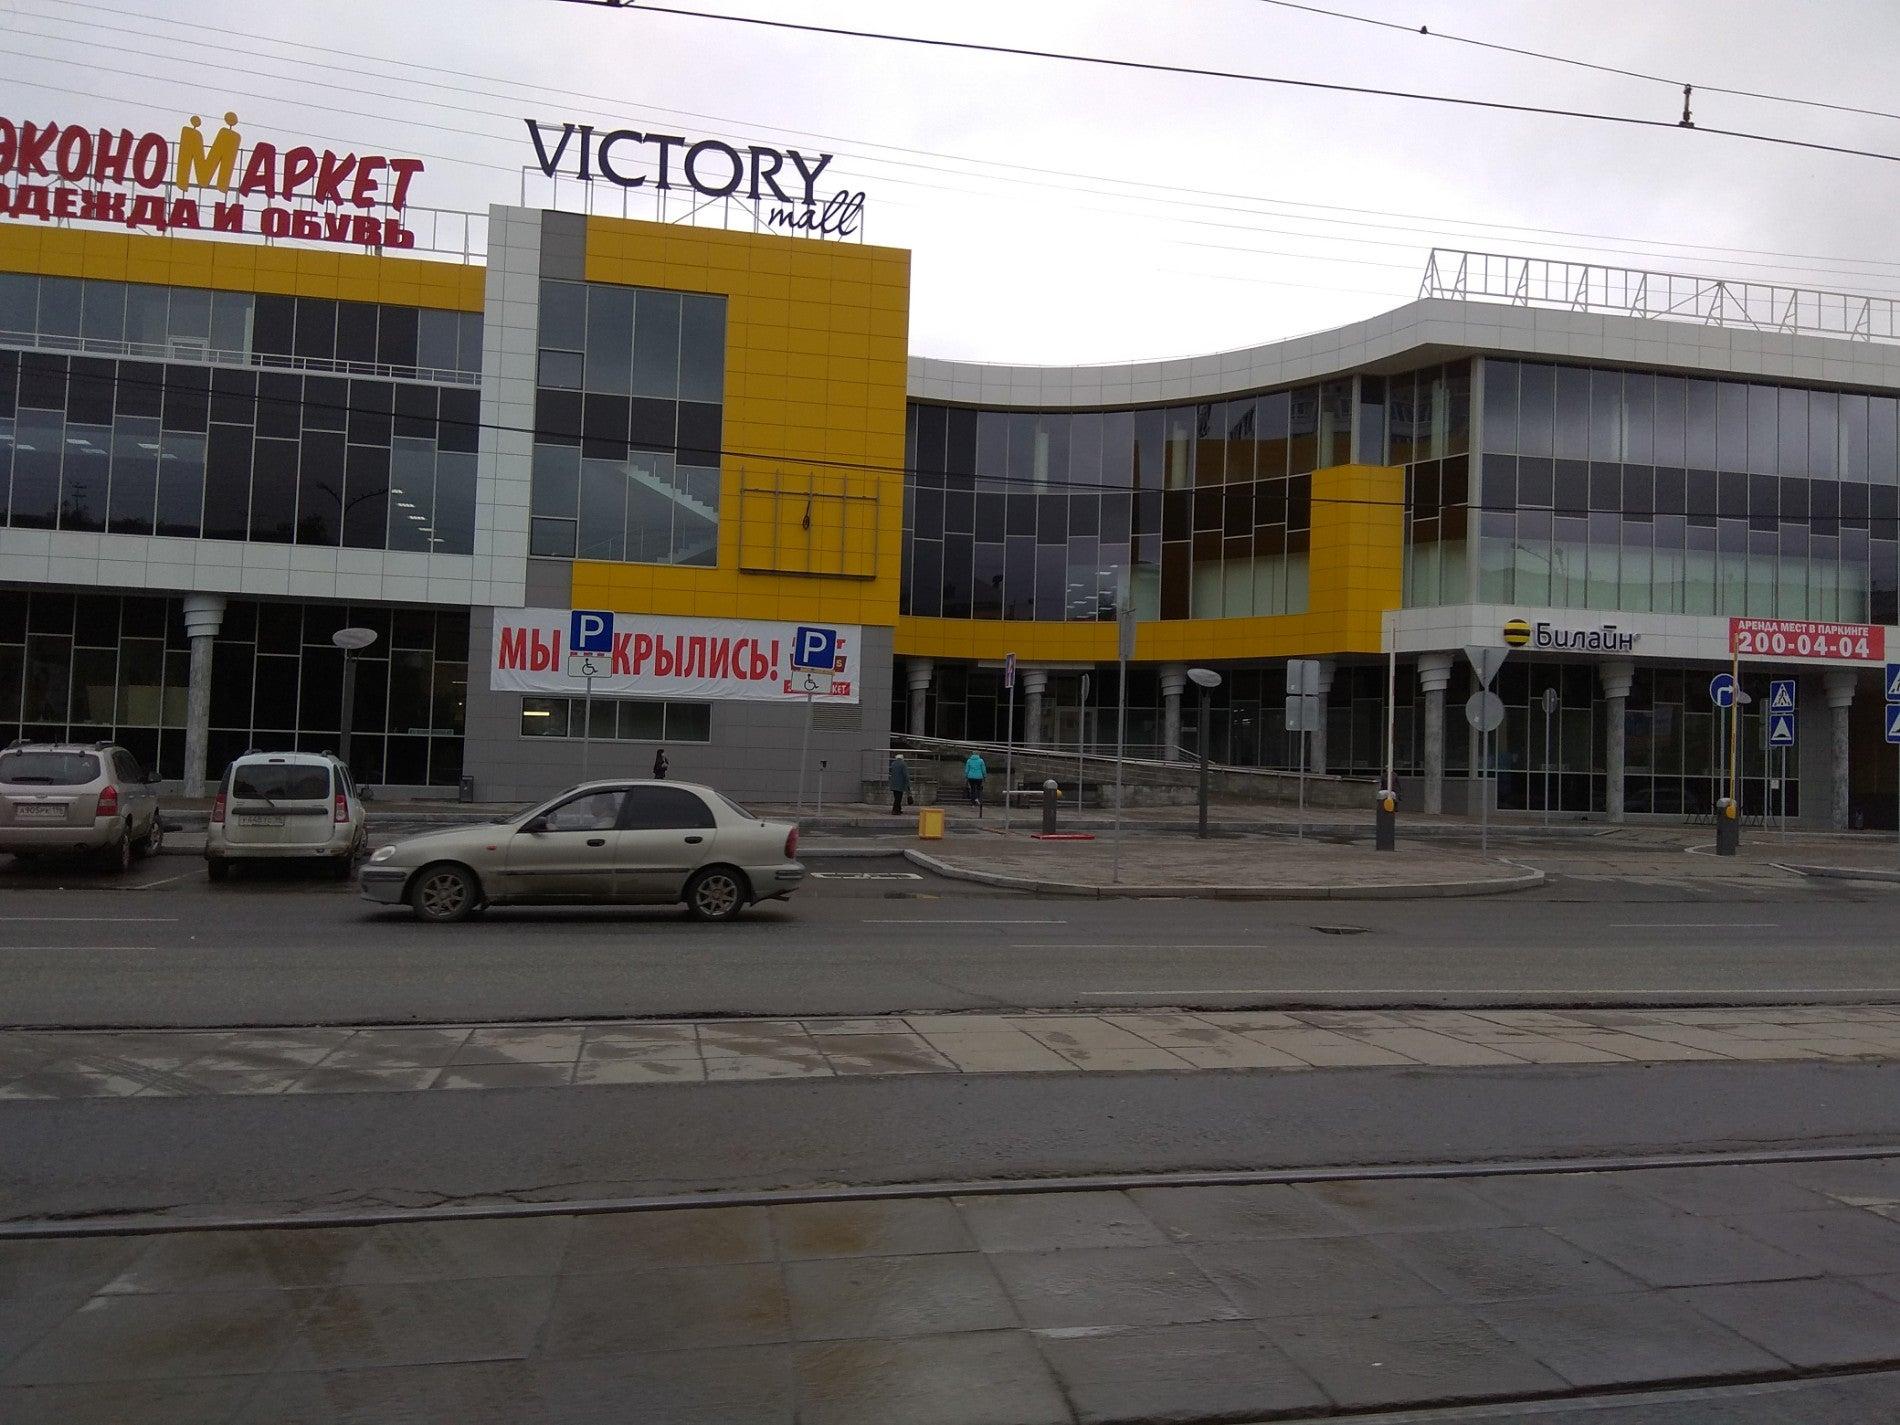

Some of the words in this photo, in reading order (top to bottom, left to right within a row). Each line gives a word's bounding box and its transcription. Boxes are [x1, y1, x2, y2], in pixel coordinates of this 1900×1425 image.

[524, 119, 833, 206] VICTORY
[213, 202, 244, 233] И
[260, 207, 414, 249] ОБУВЬ
[768, 190, 866, 236] mall
[579, 614, 604, 648] P
[1536, 622, 1633, 651] Билайн
[1737, 631, 1870, 658] 200-04-04
[1738, 620, 1779, 632] АРЕНДА
[1780, 622, 1807, 633] МЕСТ
[1808, 624, 1816, 634] В
[1818, 624, 1869, 637] ПАРКИНГЕ
[498, 627, 561, 672] МЫ
[570, 630, 780, 681] КРЫЛИСЬ!
[803, 631, 827, 663] P
